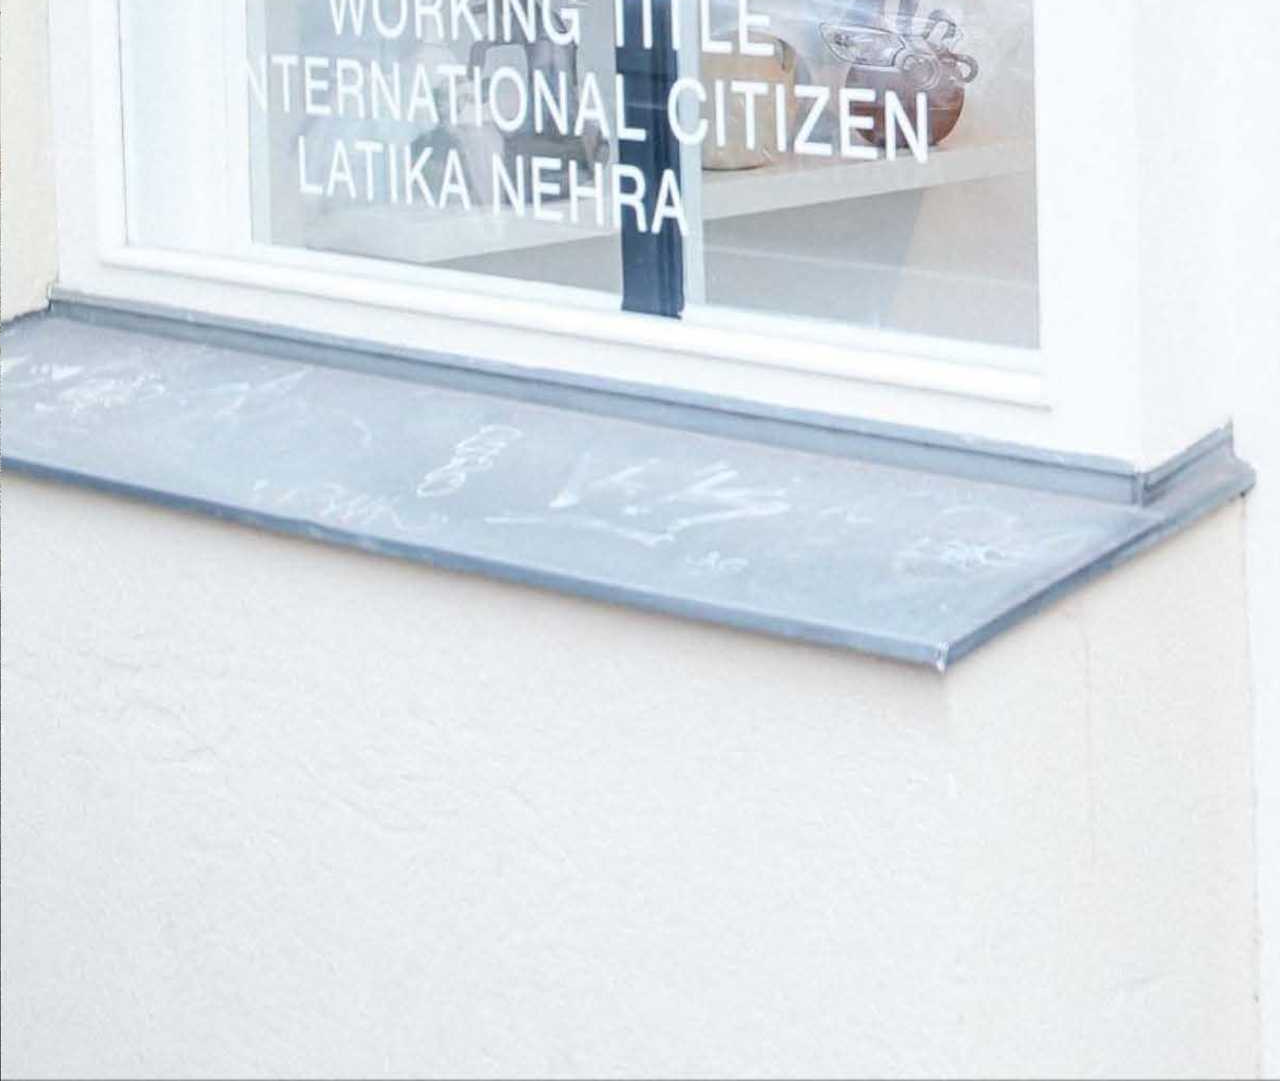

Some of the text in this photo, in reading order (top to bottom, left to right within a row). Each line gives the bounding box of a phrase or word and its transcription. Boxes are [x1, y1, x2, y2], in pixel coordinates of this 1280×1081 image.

[238, 54, 929, 164] NTERNATIONAL CITIZEN
[297, 134, 690, 237] LATIKA NEHRA
